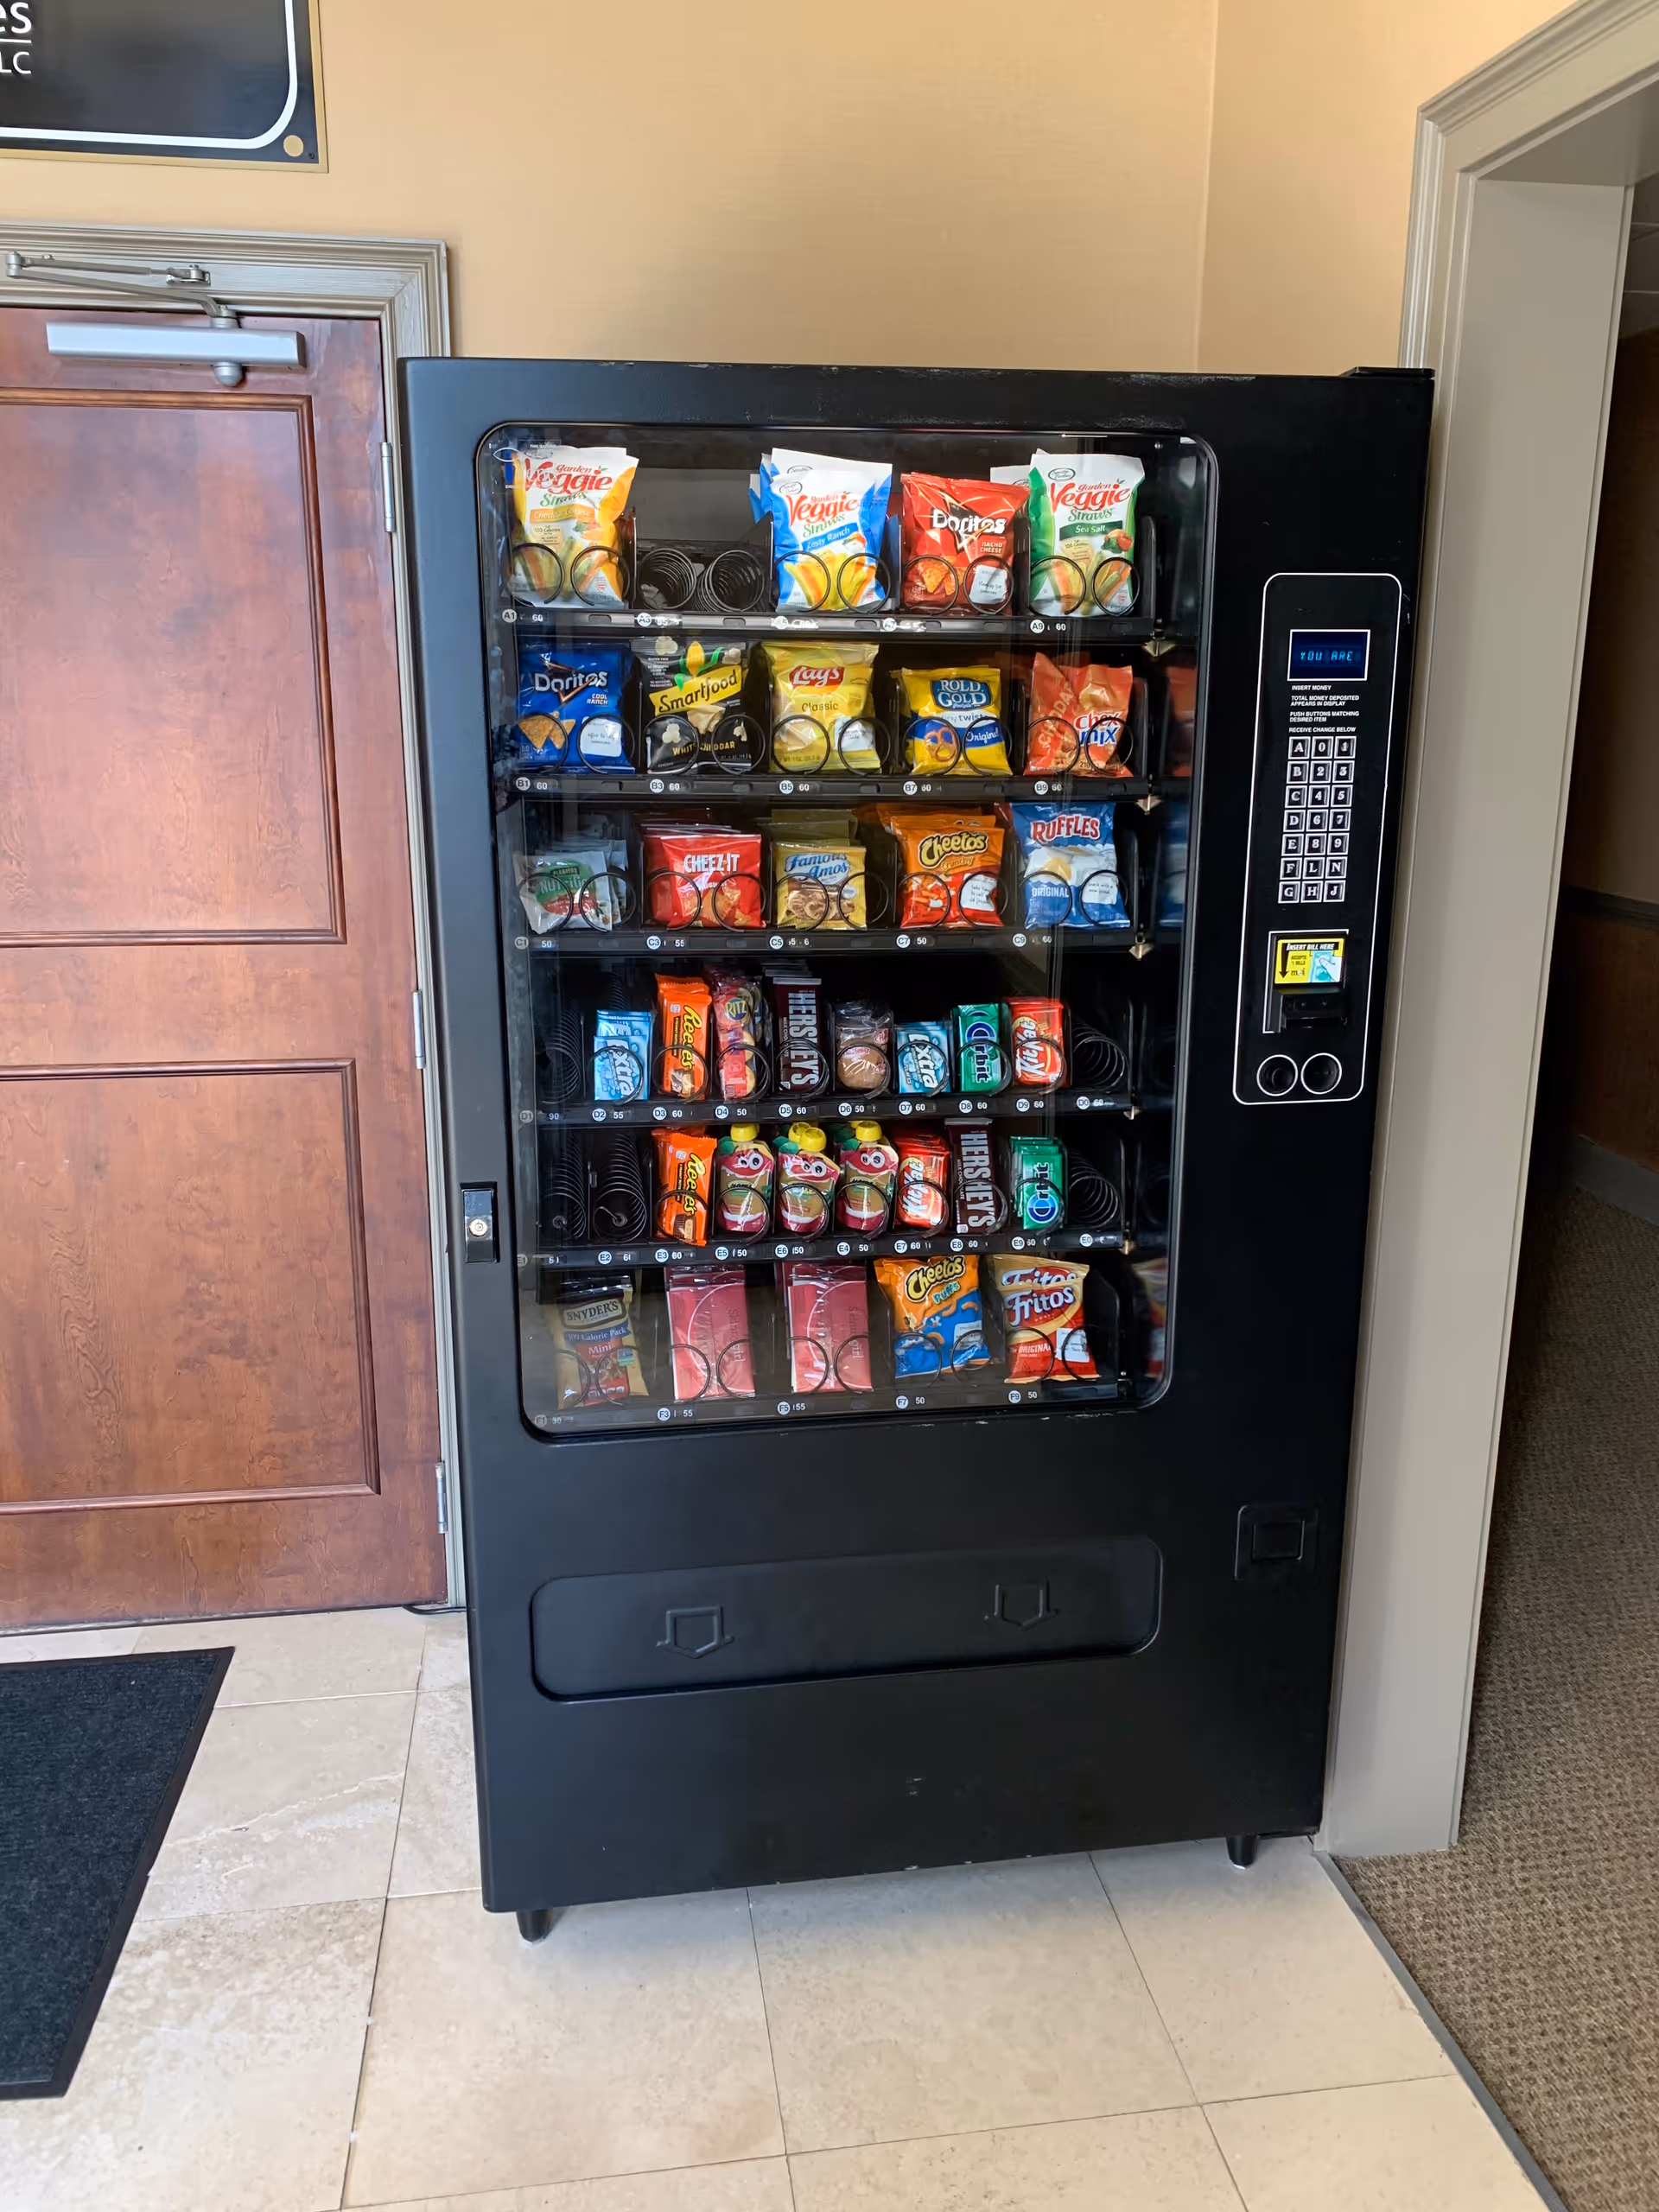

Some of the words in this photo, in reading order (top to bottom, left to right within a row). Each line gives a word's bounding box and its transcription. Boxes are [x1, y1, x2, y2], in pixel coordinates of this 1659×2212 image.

[556, 463, 592, 474] garden
[524, 458, 612, 495] Veggie
[1077, 481, 1111, 493] garden
[539, 492, 588, 507] Straws
[1051, 481, 1131, 514] Veggie
[785, 494, 859, 527] Veggie
[1068, 508, 1114, 523] Straws
[803, 514, 846, 538] Straws
[932, 508, 1007, 534] Doritos
[827, 526, 850, 541] Ranch
[1076, 524, 1090, 533] Sea
[1090, 524, 1106, 533] Salt
[504, 612, 516, 621] A1
[532, 613, 543, 622] 60
[1032, 621, 1044, 631] A9
[1056, 622, 1067, 632] 60
[1300, 651, 1323, 661] YOU
[1331, 651, 1353, 662] ARE
[535, 671, 608, 691] Doritos
[940, 679, 982, 692] ROLD
[658, 669, 738, 713] Smartfood
[938, 691, 987, 708] GOLD
[801, 701, 839, 712] Classic
[1075, 712, 1122, 730] Chex
[1080, 727, 1119, 745] mix
[1295, 742, 1304, 753] A
[1318, 742, 1326, 753] 0
[1293, 766, 1302, 777] B
[1316, 766, 1325, 777] 2
[1339, 766, 1348, 776] 3
[518, 779, 529, 788] B1
[537, 782, 548, 791] 60
[652, 781, 664, 791] B3
[670, 783, 680, 791] 60
[798, 783, 810, 791] 60
[905, 784, 916, 792] B7
[1291, 791, 1300, 802] C
[1314, 791, 1323, 801] 4
[1337, 790, 1345, 801] 5
[1289, 816, 1299, 825] D
[1313, 815, 1321, 825] 6
[1336, 815, 1344, 825] 7
[1031, 814, 1100, 843] RUFFLES
[1287, 839, 1297, 849] E
[1312, 839, 1320, 849] 8
[1334, 838, 1343, 849] 9
[920, 831, 988, 868] Cheetos
[784, 853, 848, 872] Famous
[1308, 862, 1318, 873] L
[1331, 862, 1341, 873] N
[798, 862, 848, 881] Amos
[1286, 863, 1295, 874] F
[1032, 886, 1070, 898] ORIGINAL
[1284, 887, 1294, 898] G
[1306, 887, 1317, 897] H
[1330, 886, 1338, 896] J
[648, 938, 661, 947] C3
[675, 939, 685, 948] 55
[899, 937, 909, 945] C7
[727, 1000, 747, 1018] RITZ
[965, 1021, 996, 1084] Orbit
[521, 1112, 532, 1121] D1
[549, 1112, 560, 1121] 90
[737, 1108, 747, 1116] 50
[684, 1153, 707, 1215] Reee's
[960, 1133, 996, 1228] HERSHEY'S
[911, 1242, 921, 1250] 60
[952, 1241, 963, 1249] E8
[1014, 1239, 1024, 1248] E9
[737, 1249, 747, 1257] 50
[794, 1246, 804, 1255] 50
[907, 1256, 963, 1300] Cheetos
[566, 1300, 619, 1321] SNYDER'S
[1005, 1287, 1075, 1326] Fritos
[609, 1326, 626, 1337] Pack
[588, 1342, 612, 1355] Mini
[897, 1398, 907, 1407] F7
[683, 1409, 693, 1418] 55
[779, 1404, 789, 1413] F5
